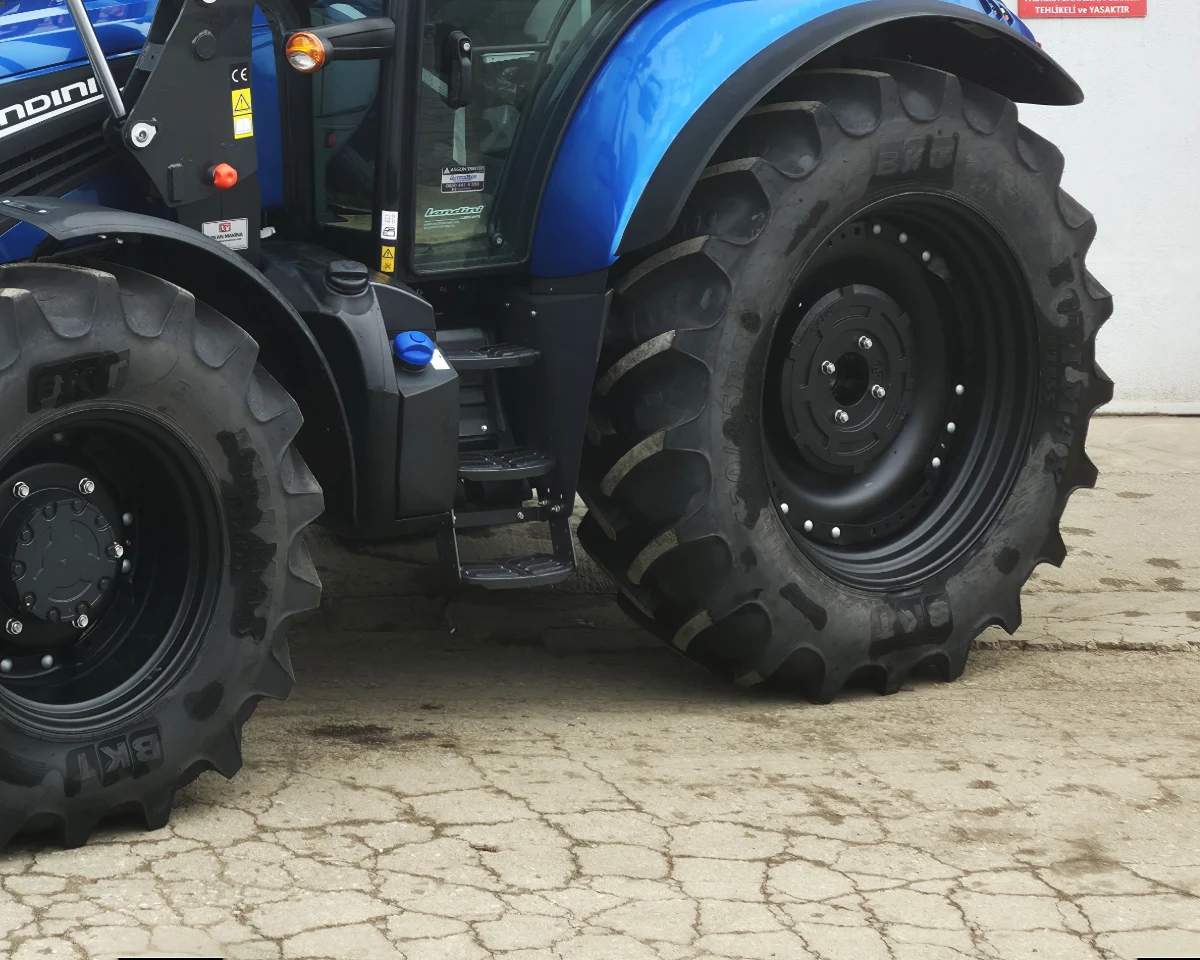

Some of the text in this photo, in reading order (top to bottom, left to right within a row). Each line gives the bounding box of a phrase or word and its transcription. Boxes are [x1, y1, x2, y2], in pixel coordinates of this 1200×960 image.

[1035, 5, 1076, 14] TEHLİKELİ
[232, 68, 248, 82] CE
[76, 732, 163, 781] BKT
